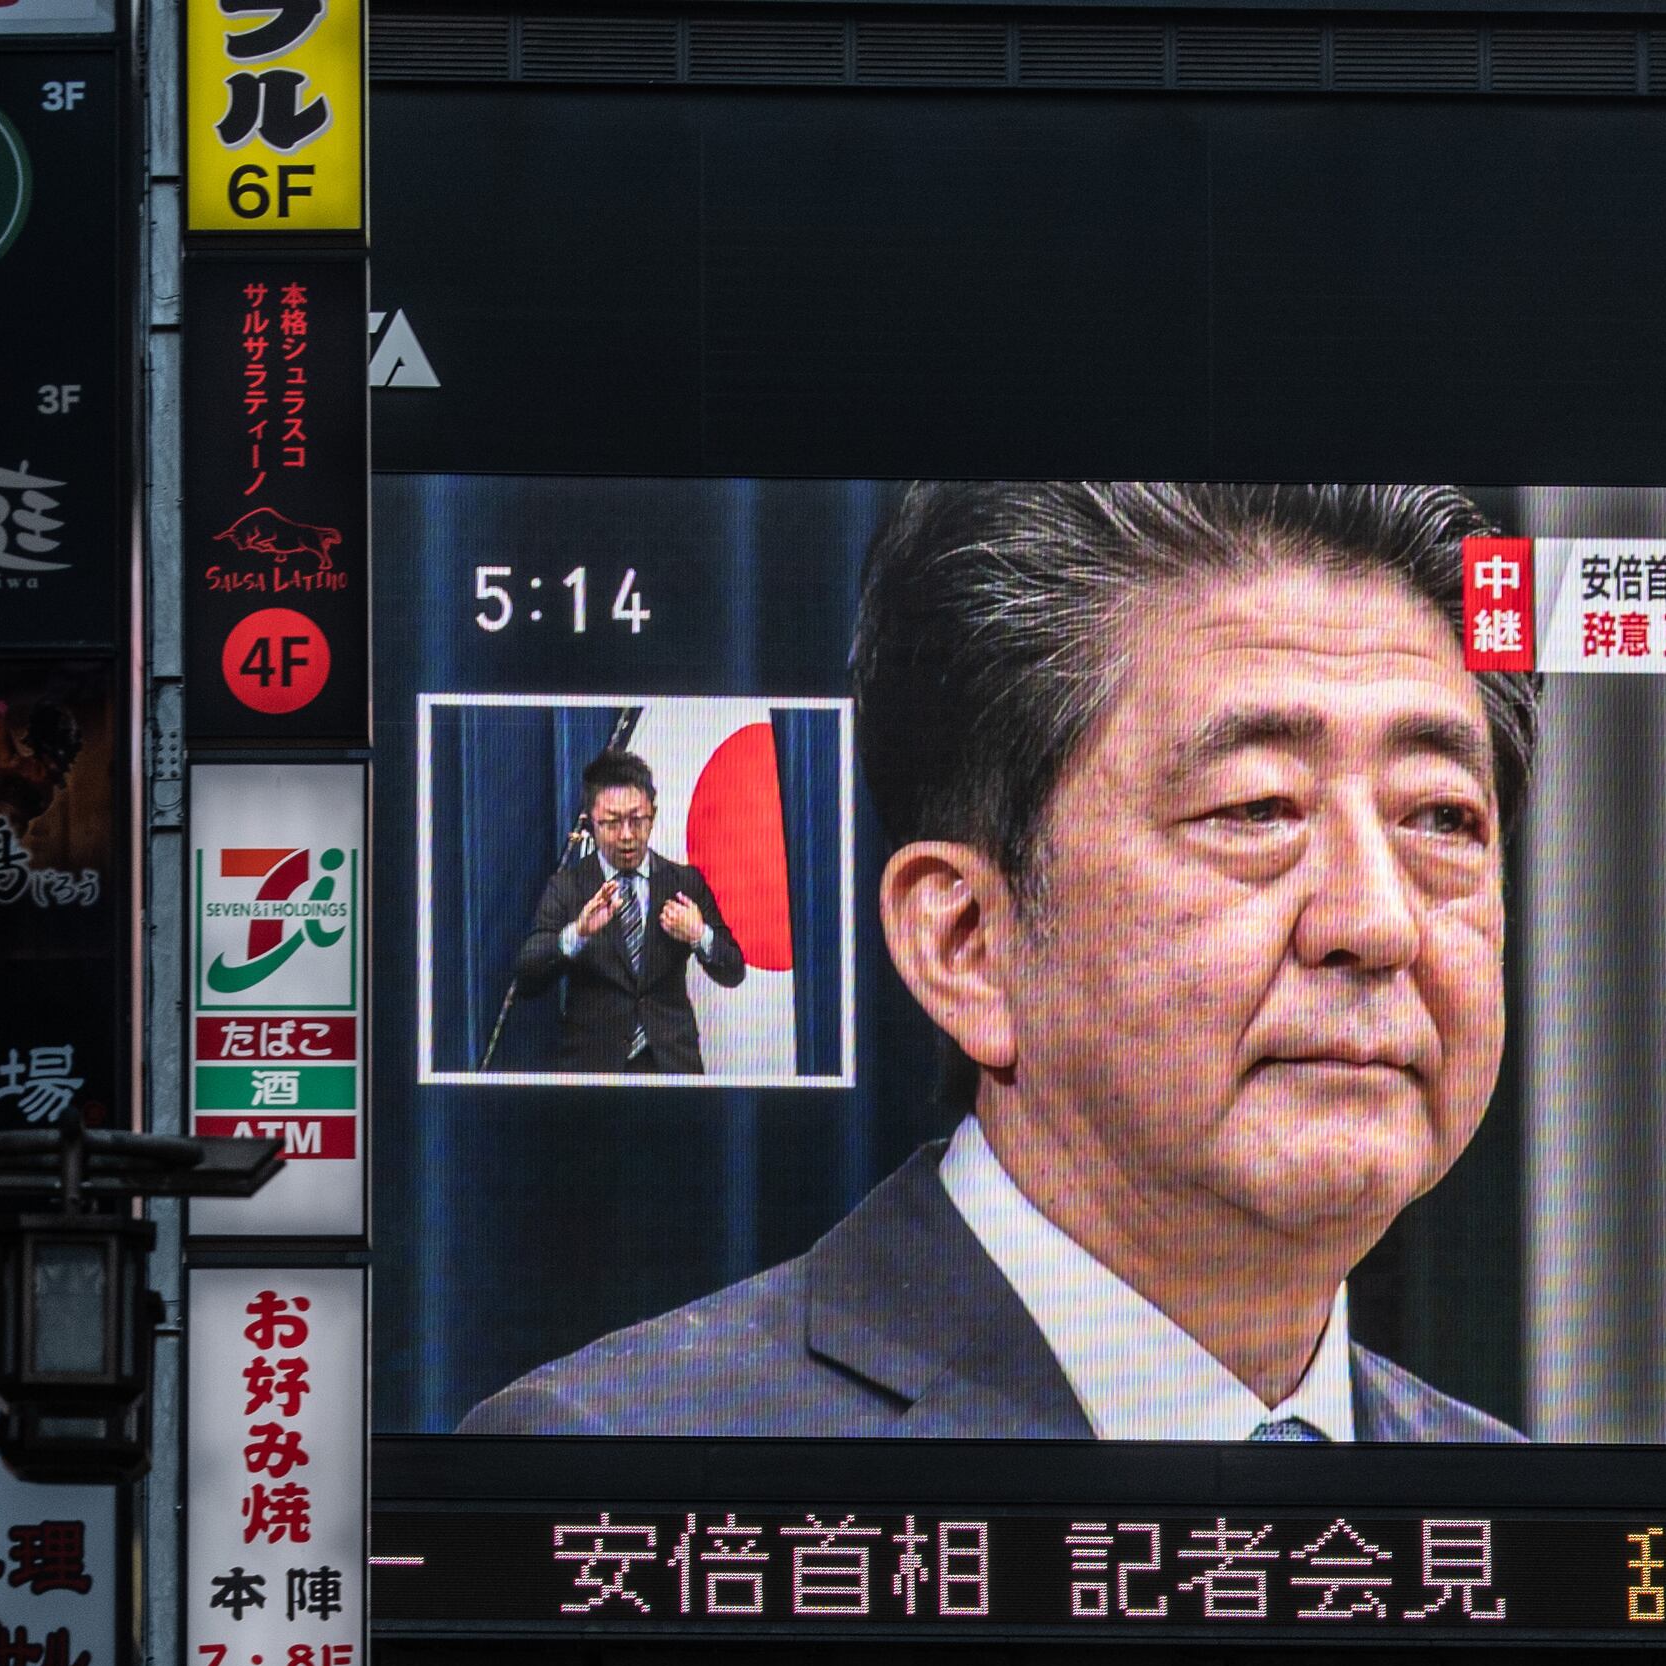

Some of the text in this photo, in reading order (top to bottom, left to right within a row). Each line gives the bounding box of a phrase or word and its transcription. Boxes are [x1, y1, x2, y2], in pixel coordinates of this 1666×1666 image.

[41, 81, 86, 112] 3F
[226, 163, 317, 221] 6F
[36, 384, 82, 415] 3F
[242, 282, 270, 497] サルサラティーノ
[279, 281, 309, 471] 本格シュラスコ
[474, 566, 651, 635] 5:14
[1474, 554, 1523, 656] 中継
[239, 635, 311, 688] 4F
[1582, 613, 1652, 660] 辞意
[219, 1019, 334, 1058] たばこ
[249, 1069, 300, 1106] 酒
[242, 1290, 312, 1546] お好み焼
[209, 1565, 343, 1622] 本陣
[553, 1512, 989, 1617] 安倍首相
[1065, 1516, 1507, 1621] 記者会見
